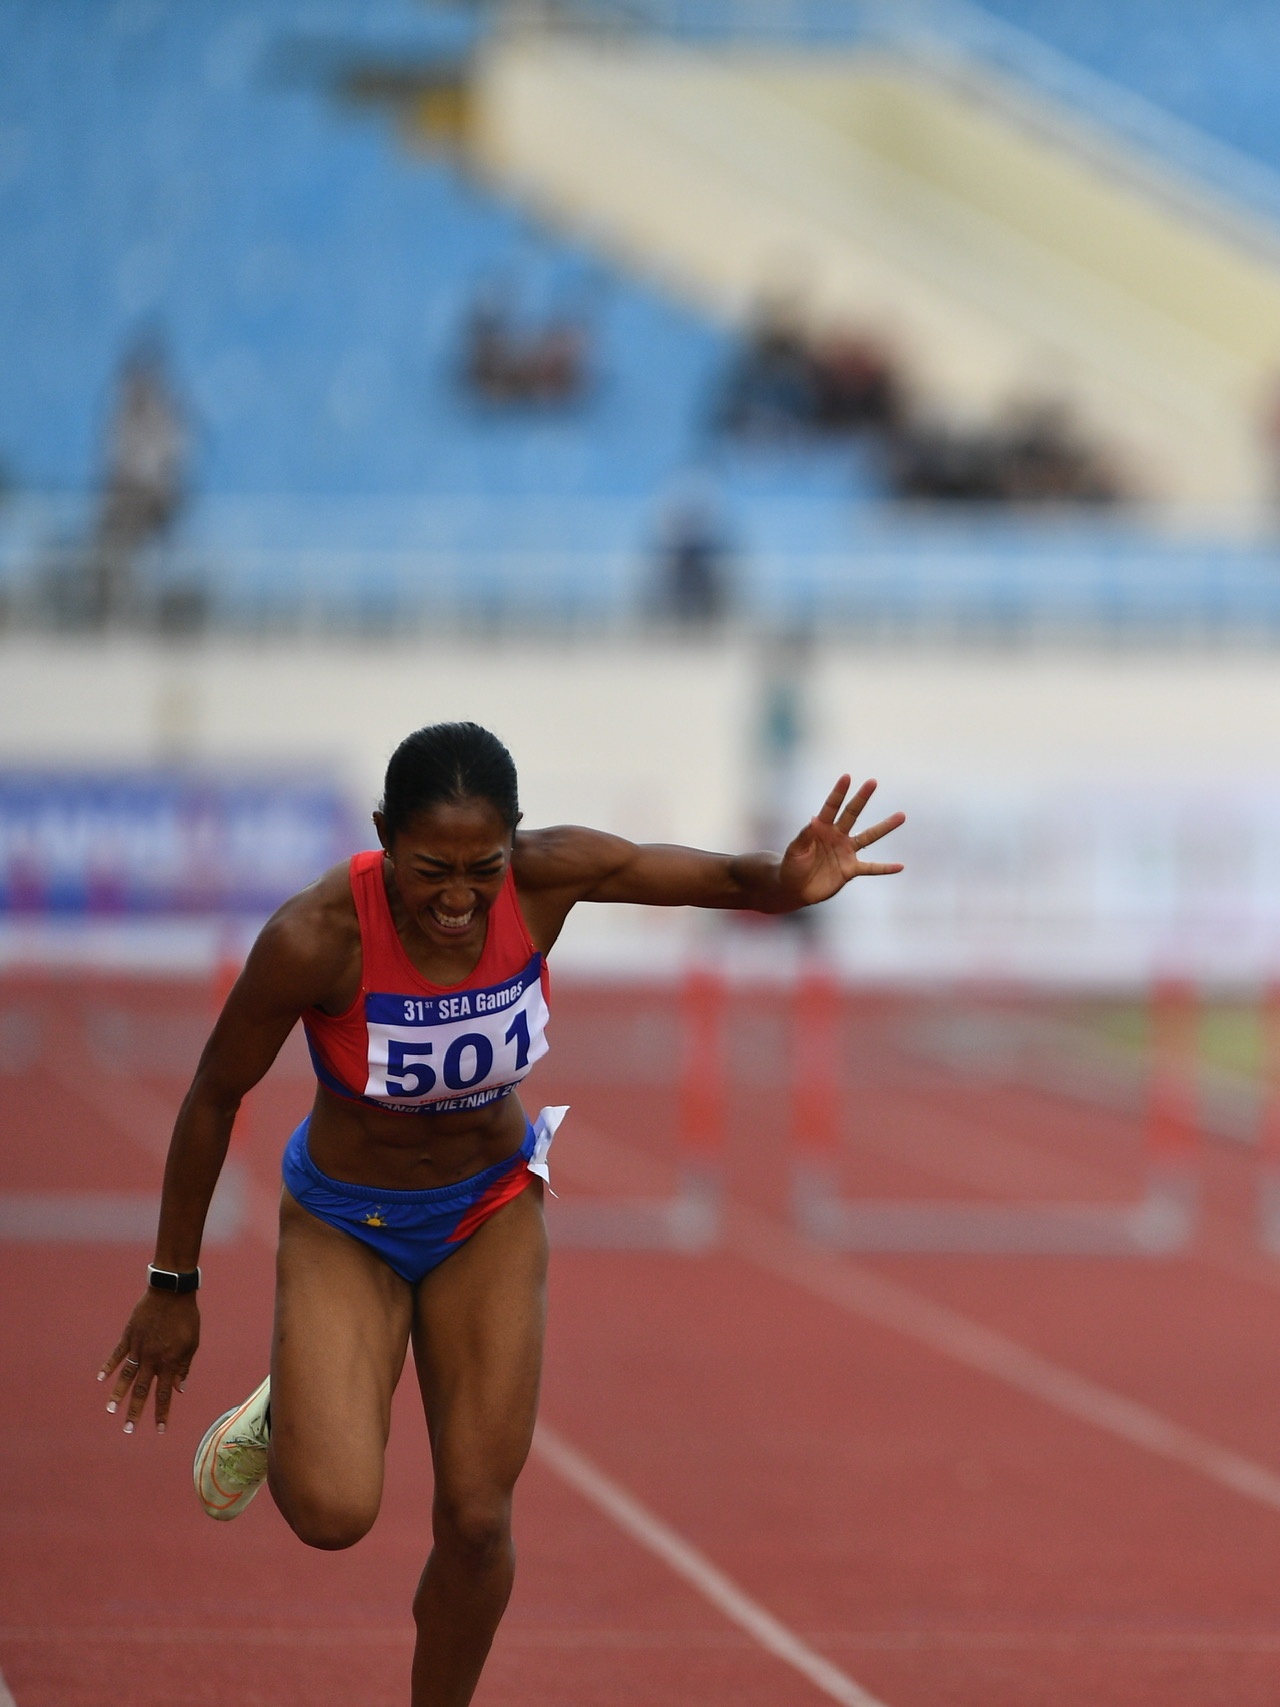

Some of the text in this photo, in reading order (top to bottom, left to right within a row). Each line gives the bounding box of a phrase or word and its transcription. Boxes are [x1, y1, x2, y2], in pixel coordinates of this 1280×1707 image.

[438, 996, 471, 1019] SEA
[476, 981, 523, 1012] Games
[385, 1008, 531, 1097] 501
[435, 1088, 500, 1111] VIETNAM
